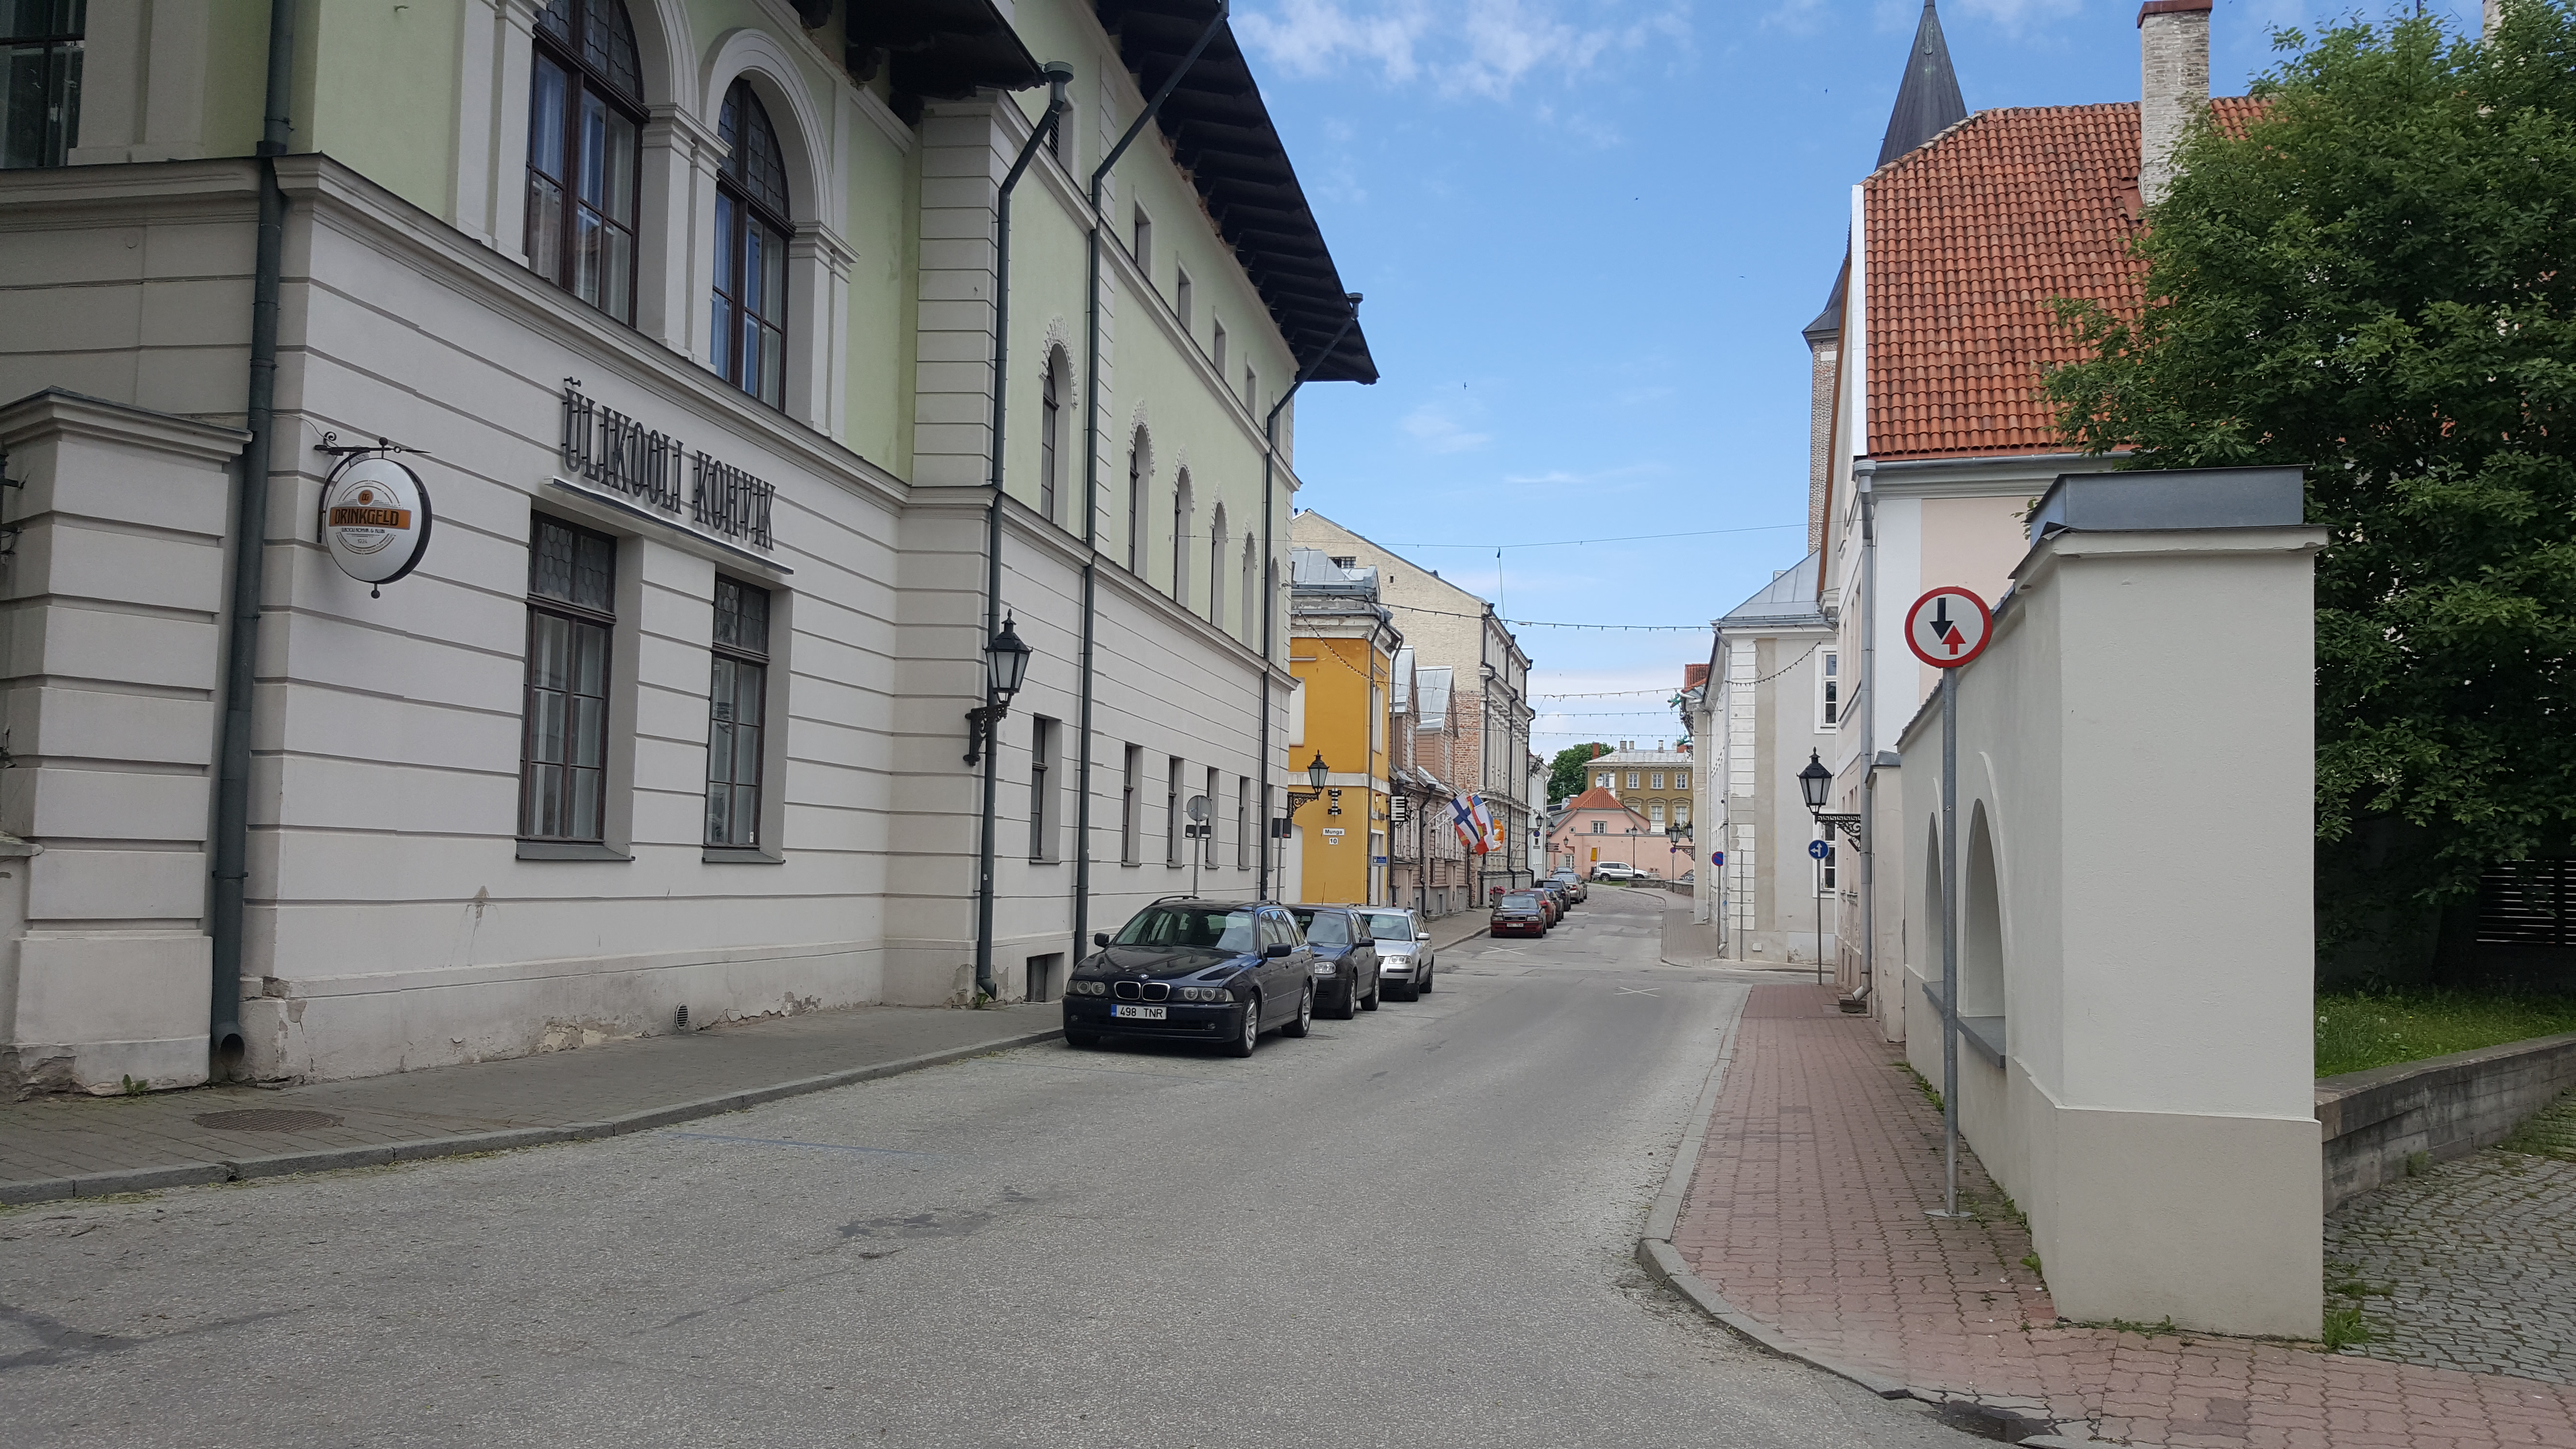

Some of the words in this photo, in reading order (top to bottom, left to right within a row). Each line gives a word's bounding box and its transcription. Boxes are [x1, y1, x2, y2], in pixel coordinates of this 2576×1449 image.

[564, 377, 684, 515] ÜLIKOOLI
[694, 450, 775, 551] KOHVIK
[335, 508, 399, 526] DRINKGELD
[1120, 1007, 1136, 1016] 498
[1143, 1008, 1163, 1017] TNR
